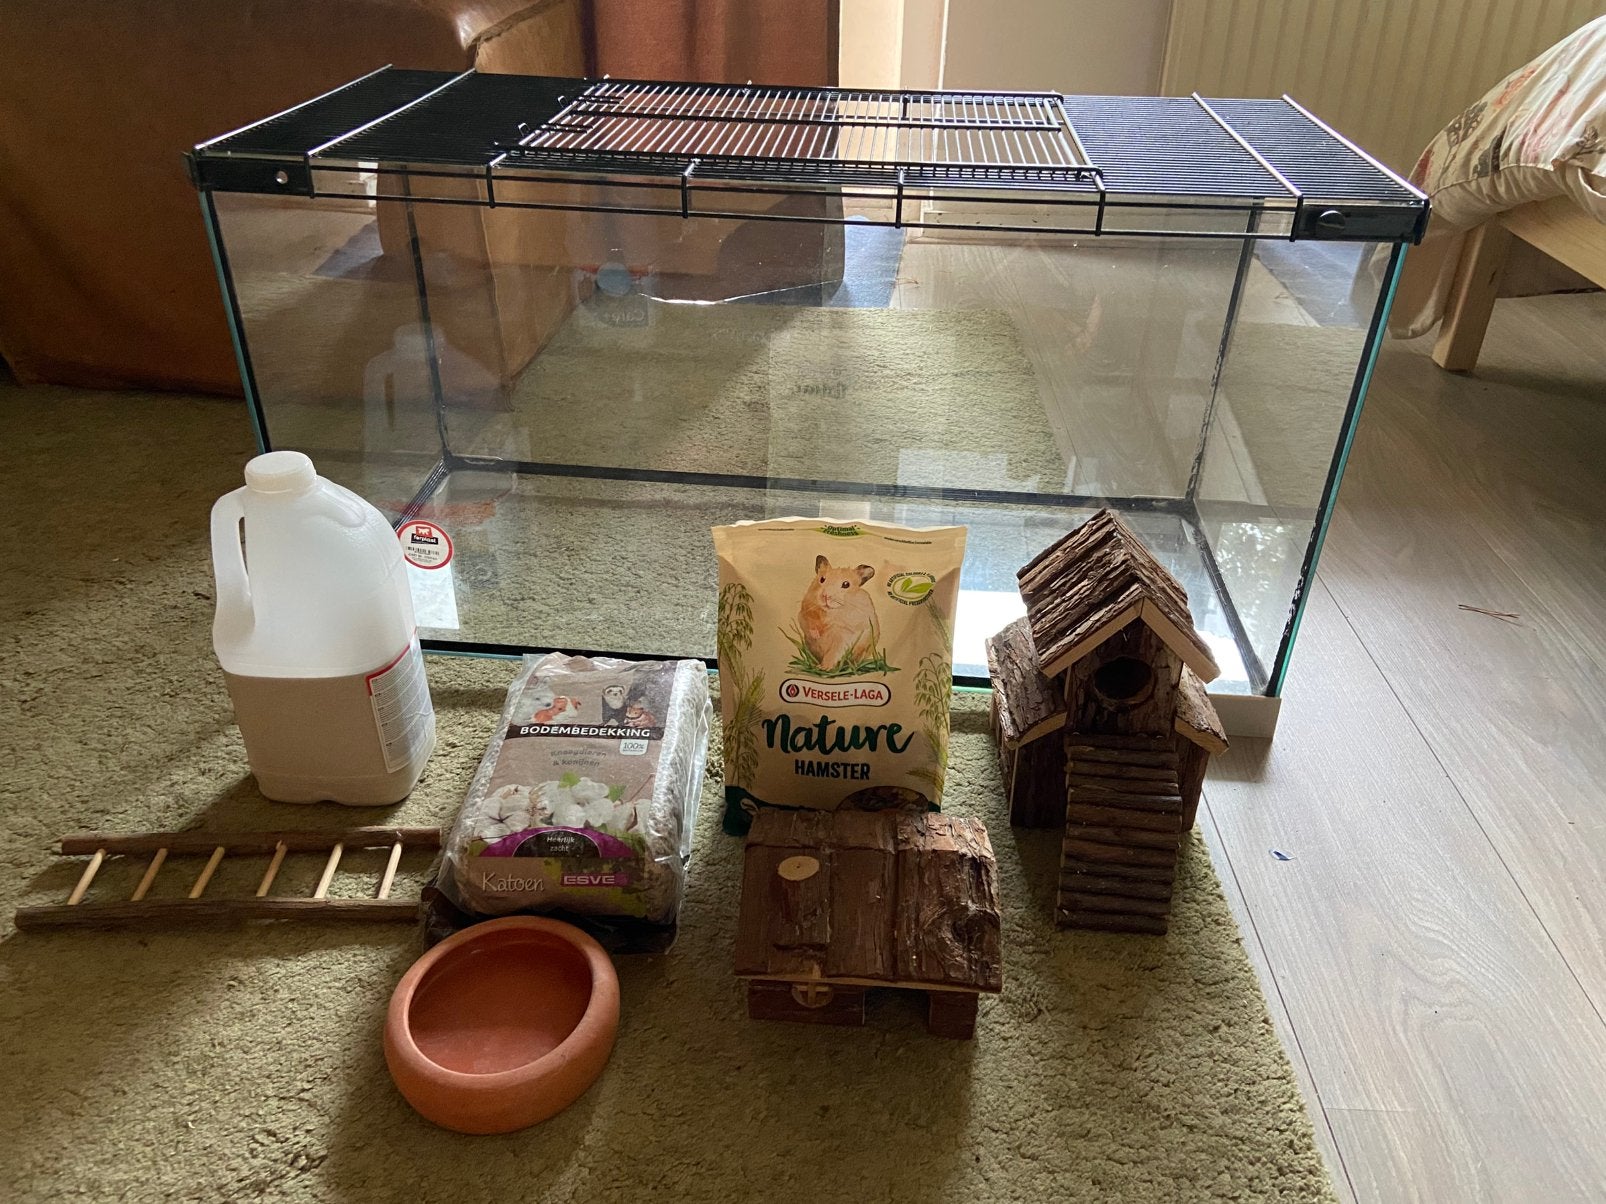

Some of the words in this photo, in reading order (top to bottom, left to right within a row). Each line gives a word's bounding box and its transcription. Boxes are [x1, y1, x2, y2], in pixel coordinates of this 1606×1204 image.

[803, 686, 884, 701] VERSELE-LAGA
[519, 725, 651, 738] BODEMBEDEKKING
[795, 759, 871, 780] HAMSTER
[482, 871, 544, 892] Katoen
[563, 875, 615, 885] ESVE
